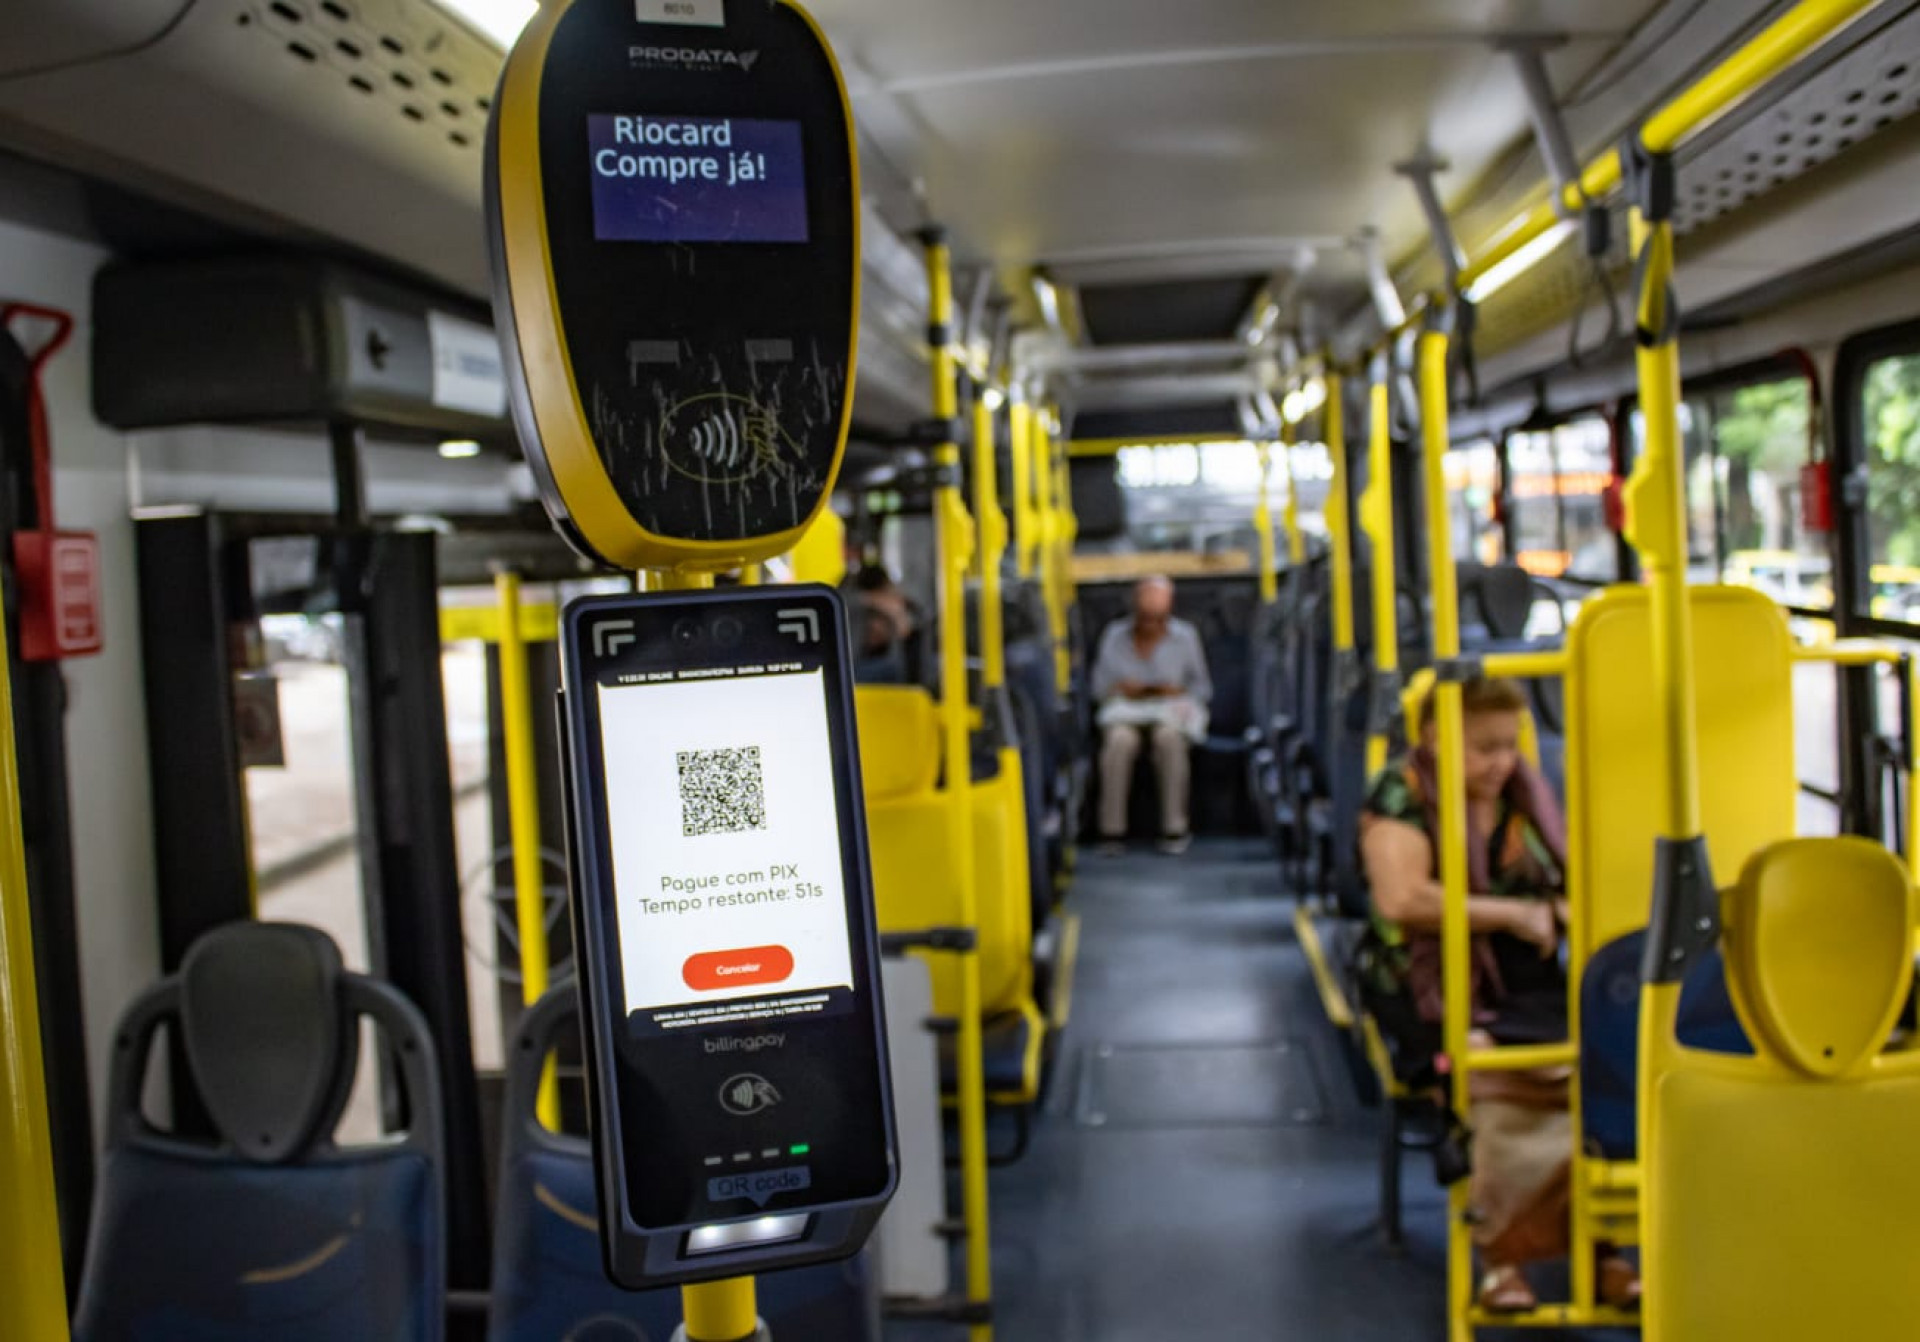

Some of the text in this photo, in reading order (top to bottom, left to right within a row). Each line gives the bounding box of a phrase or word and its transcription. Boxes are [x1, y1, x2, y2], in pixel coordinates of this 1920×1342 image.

[628, 46, 738, 63] PRODATA
[614, 115, 731, 147] Riocard
[595, 149, 766, 186] Compre já!
[660, 863, 799, 894] Pague com PIX
[639, 882, 823, 915] Tempo restante: 51s
[715, 963, 761, 976] Cancelar
[704, 1032, 786, 1053] billingpay
[718, 1168, 801, 1197] QR code
